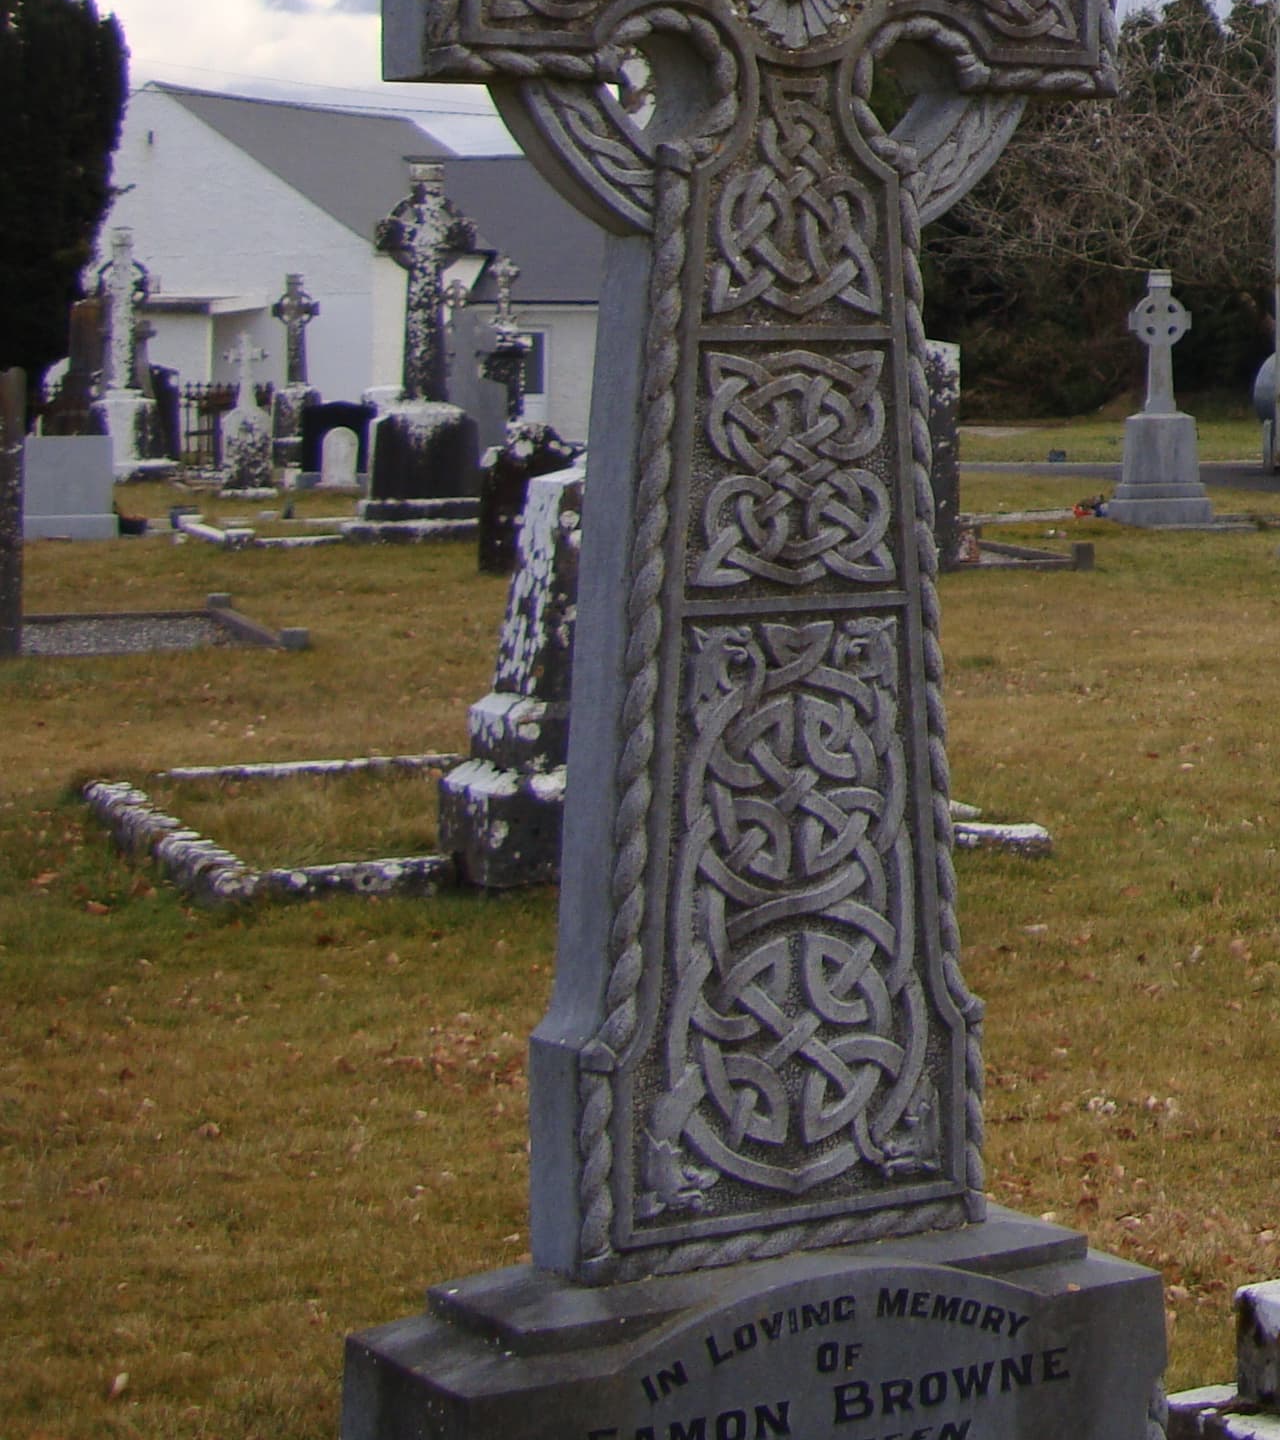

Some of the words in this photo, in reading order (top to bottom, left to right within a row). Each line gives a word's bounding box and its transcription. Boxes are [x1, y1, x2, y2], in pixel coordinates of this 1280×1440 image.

[641, 1361, 689, 1403] IN
[705, 1295, 856, 1367] LOVING
[876, 1287, 1030, 1337] MEMORY
[816, 1341, 864, 1372] OF
[587, 1400, 792, 1440] MON
[833, 1347, 1071, 1424] BROWNE
